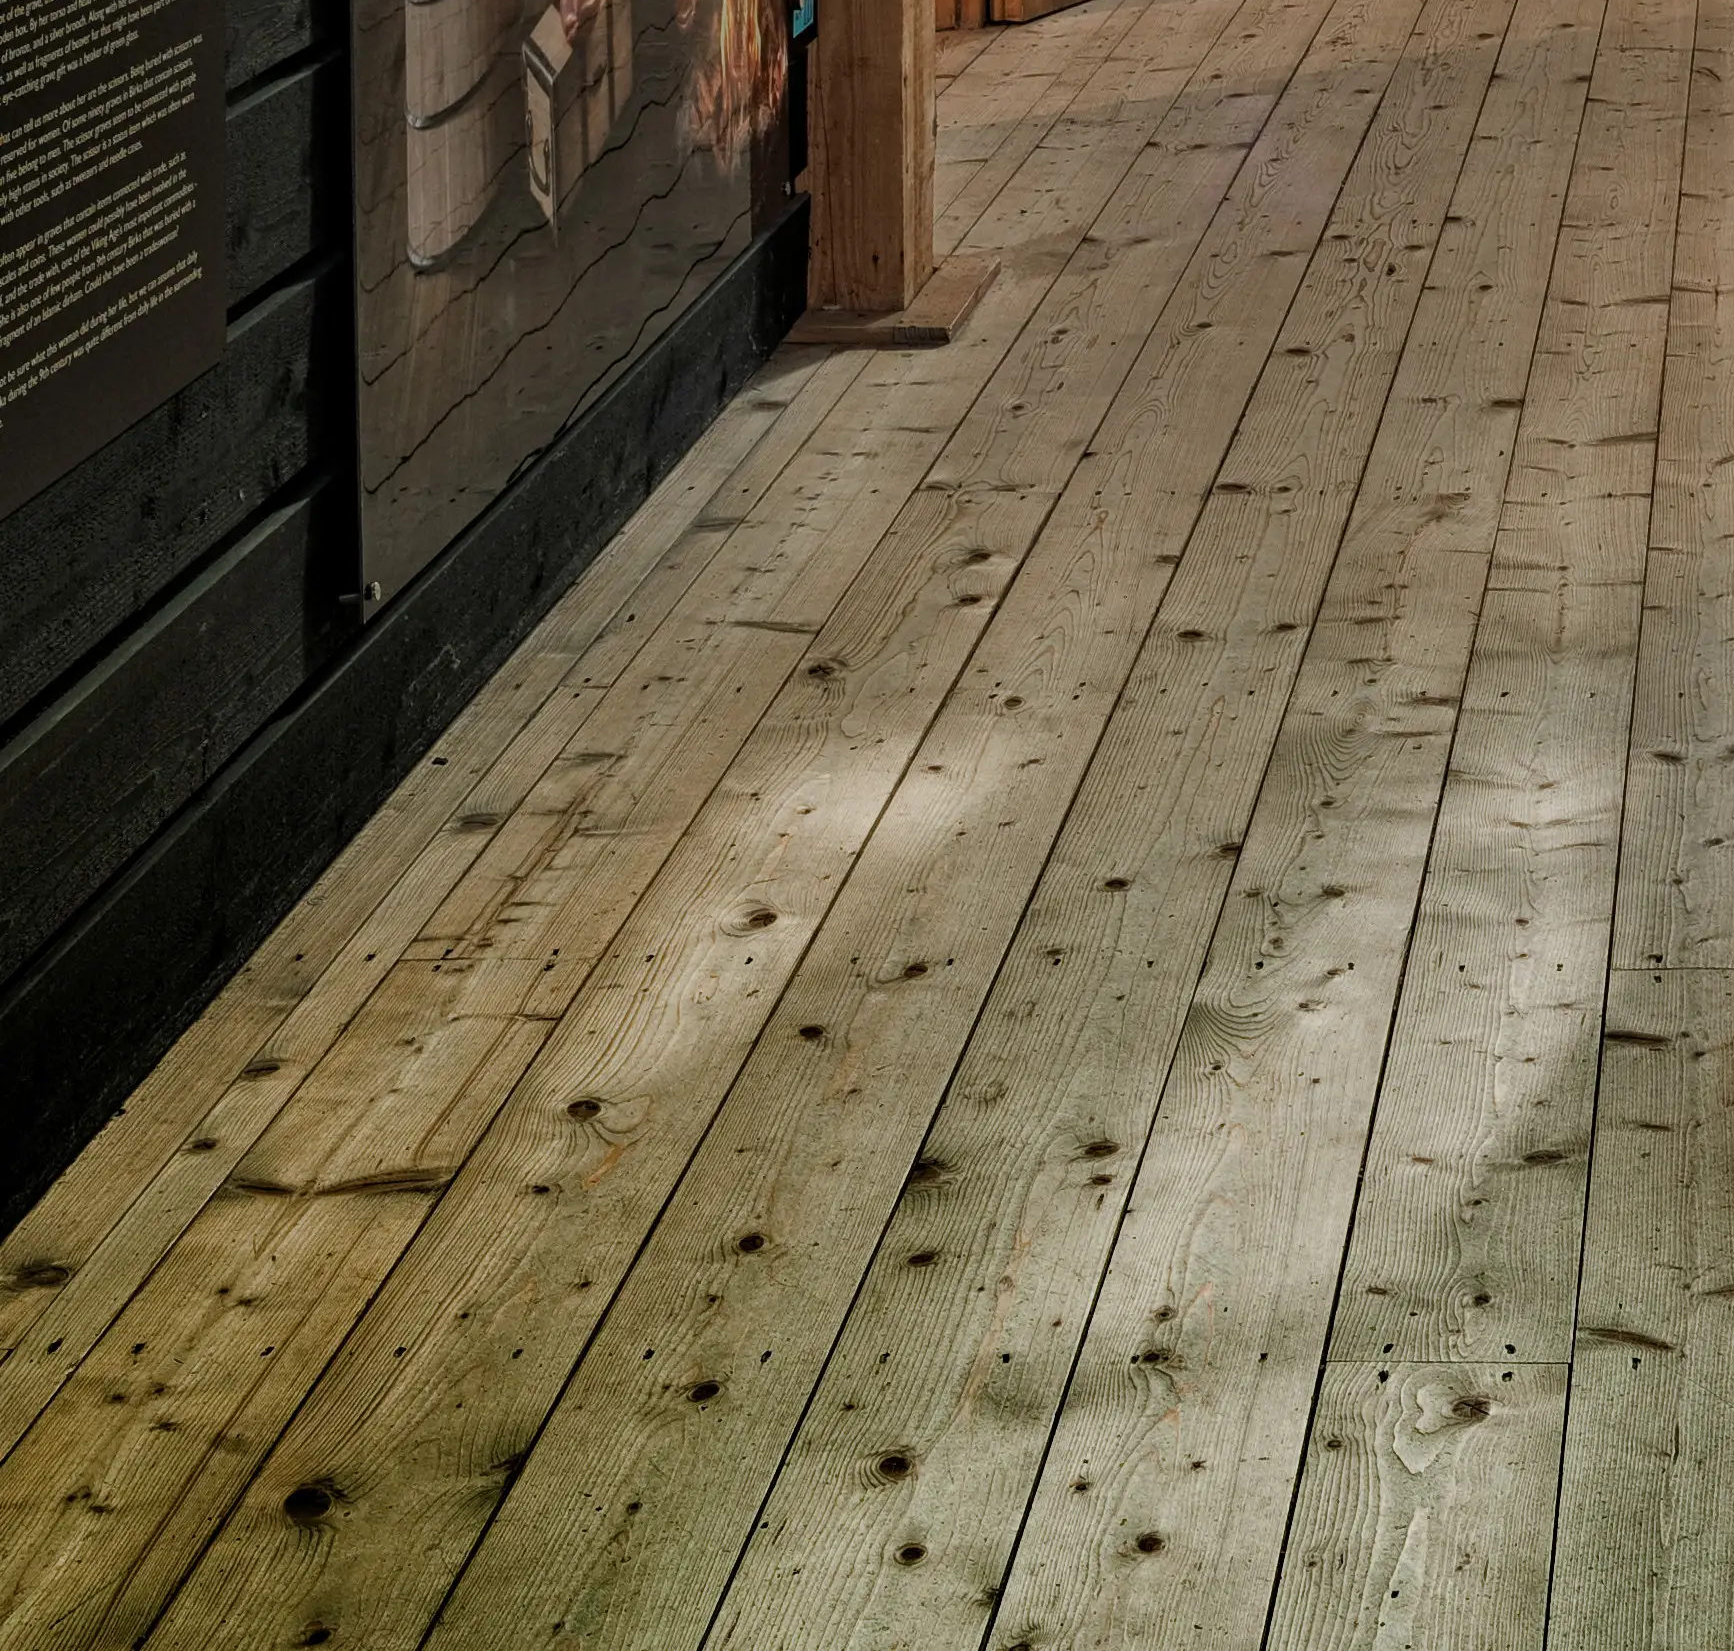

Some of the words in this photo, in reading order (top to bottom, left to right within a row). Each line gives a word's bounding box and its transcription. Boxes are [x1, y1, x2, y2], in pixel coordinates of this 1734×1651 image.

[0, 209, 14, 225] with
[15, 201, 32, 217] other
[50, 181, 64, 197] such
